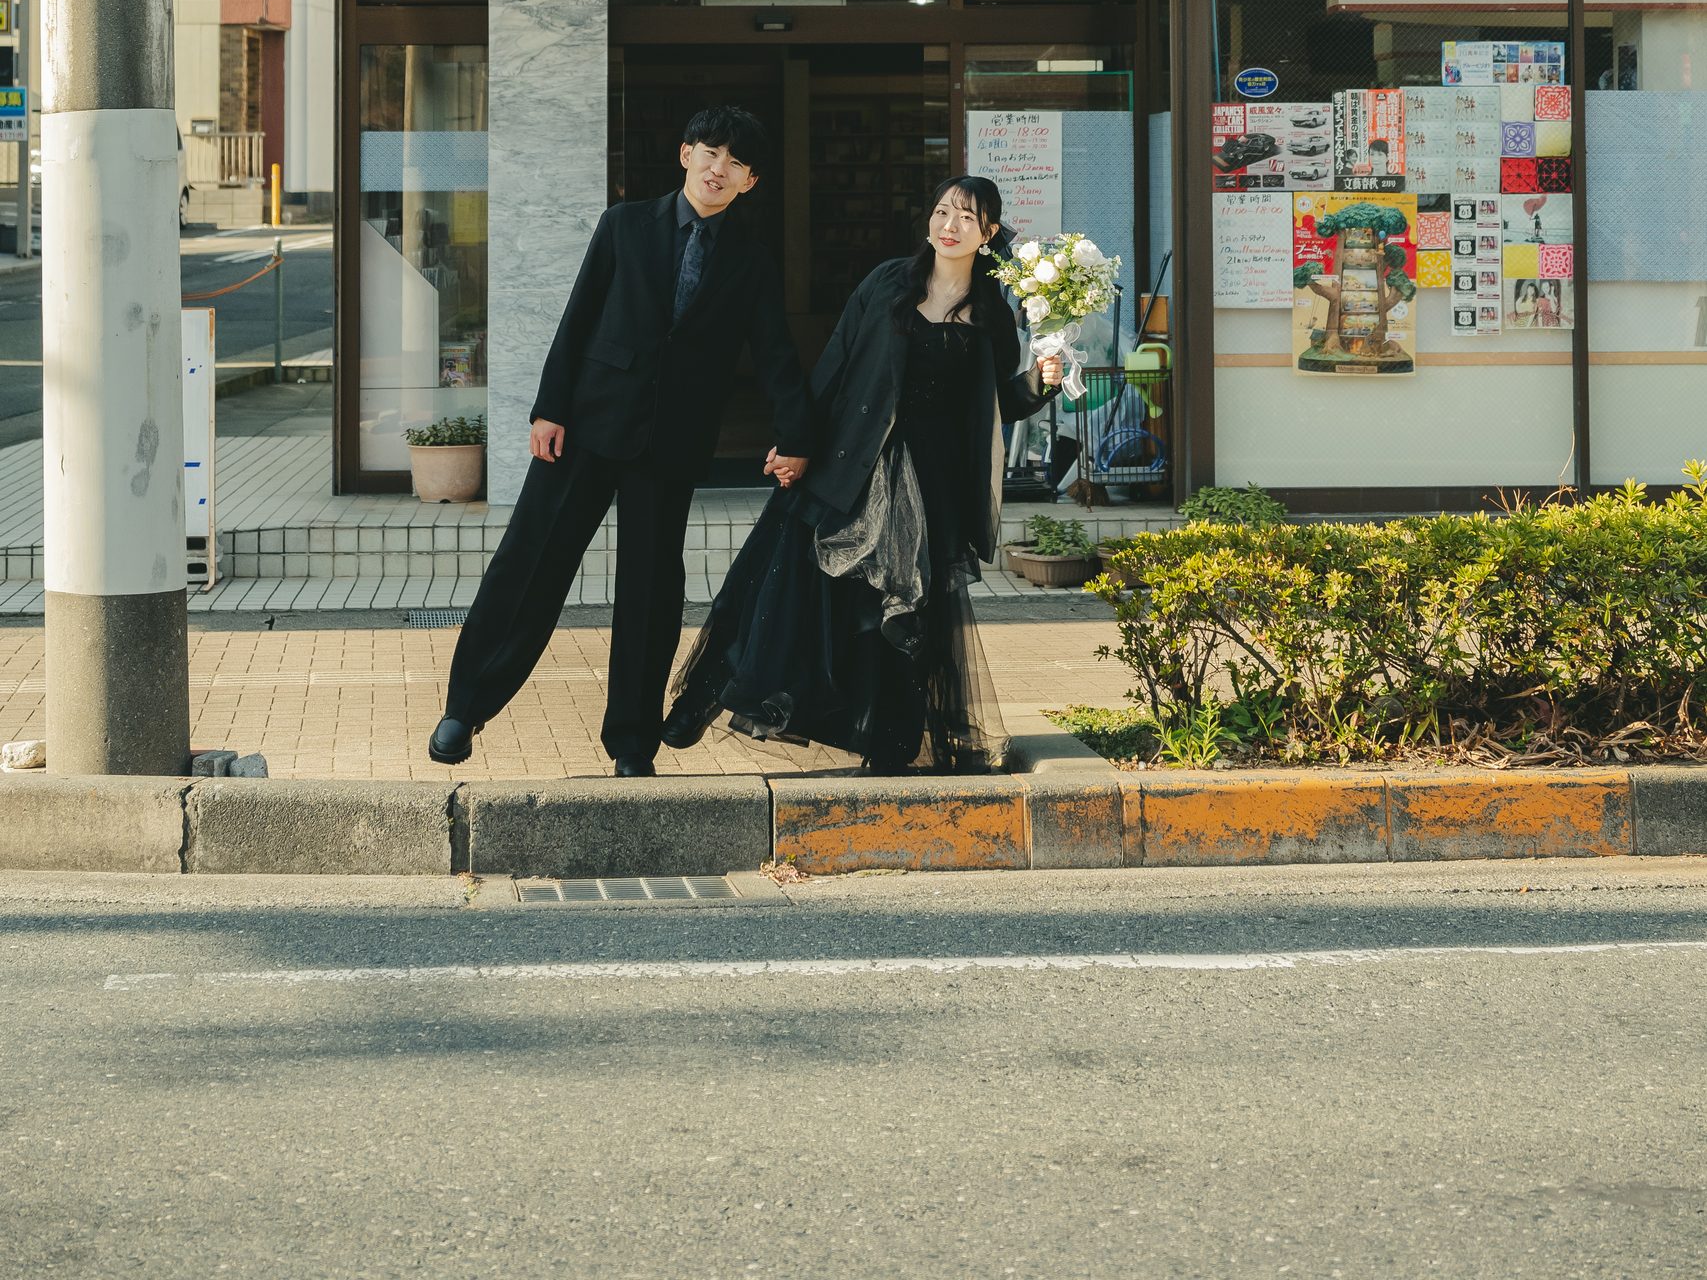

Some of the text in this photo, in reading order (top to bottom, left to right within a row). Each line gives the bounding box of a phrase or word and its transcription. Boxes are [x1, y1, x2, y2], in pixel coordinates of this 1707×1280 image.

[1213, 106, 1245, 116] JAPANESE
[991, 113, 1040, 126] 営業時間
[1227, 116, 1245, 126] CARS
[1343, 177, 1396, 190] 文藝春秋 2月号
[1226, 194, 1272, 205] 営業時間
